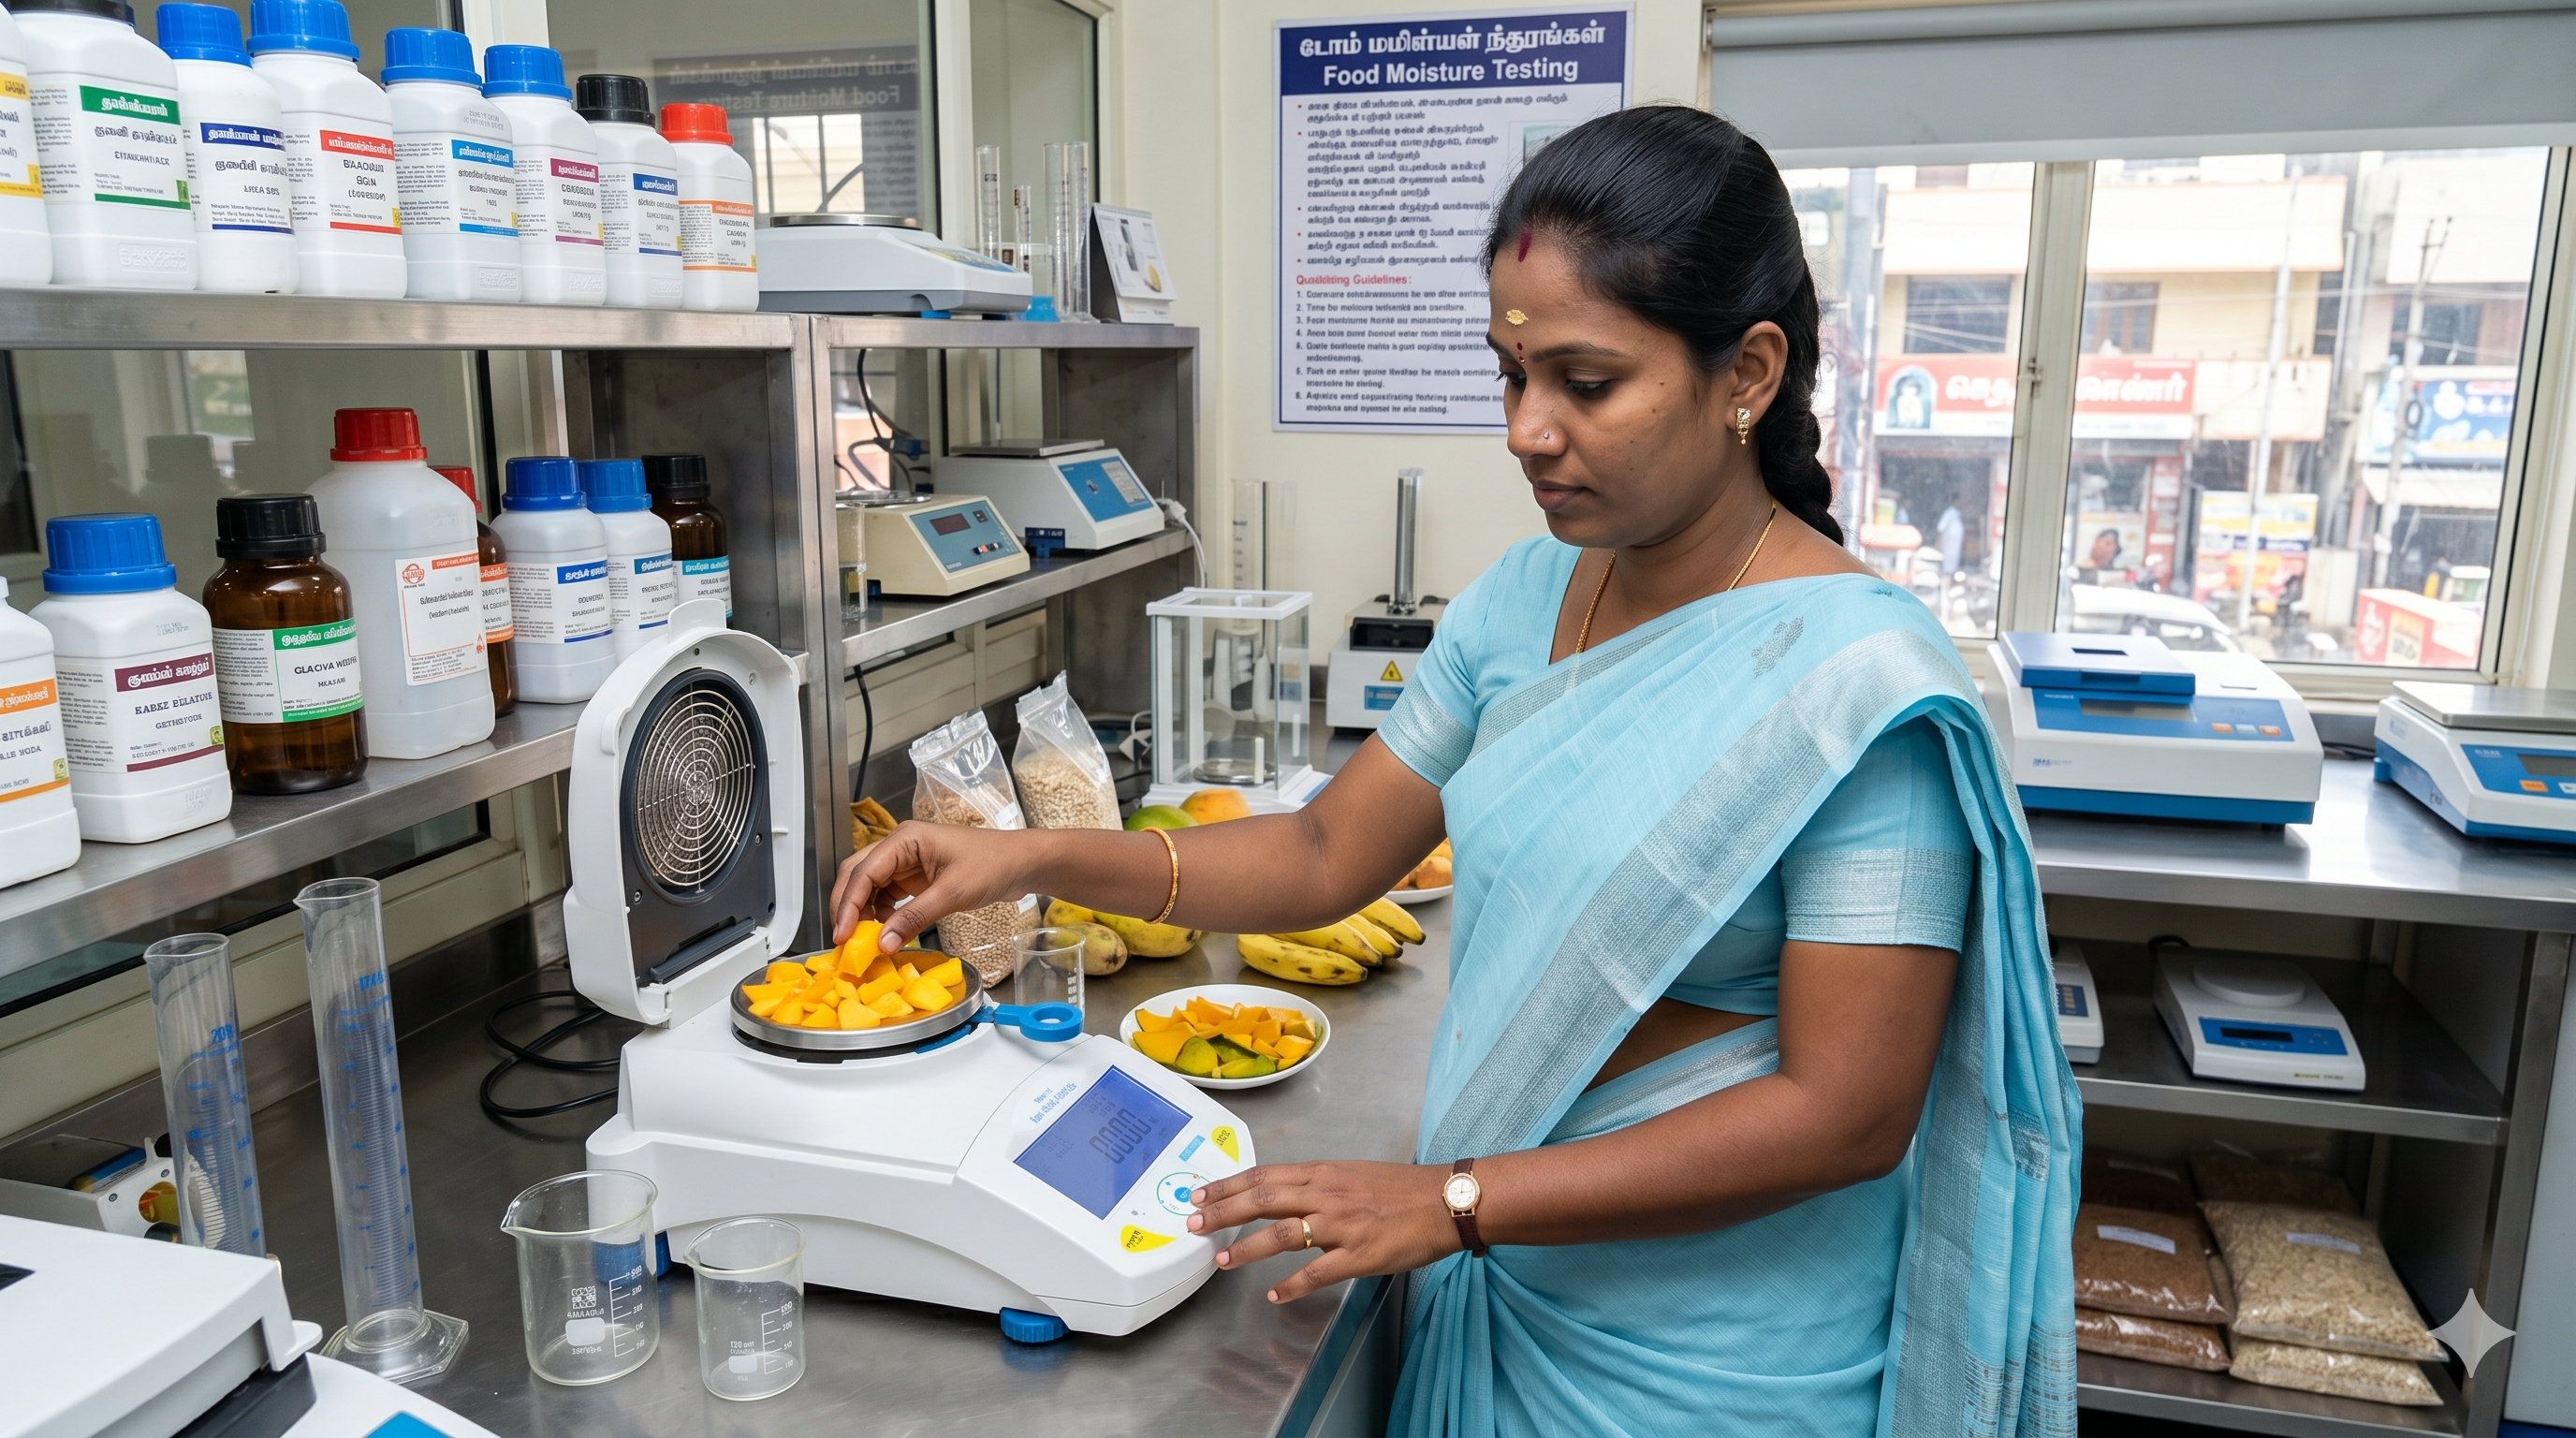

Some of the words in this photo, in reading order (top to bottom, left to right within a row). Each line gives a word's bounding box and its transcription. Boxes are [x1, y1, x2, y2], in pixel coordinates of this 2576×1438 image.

[1324, 63, 1380, 86] Food
[1386, 60, 1486, 84] Moisture
[1492, 57, 1579, 82] Testing
